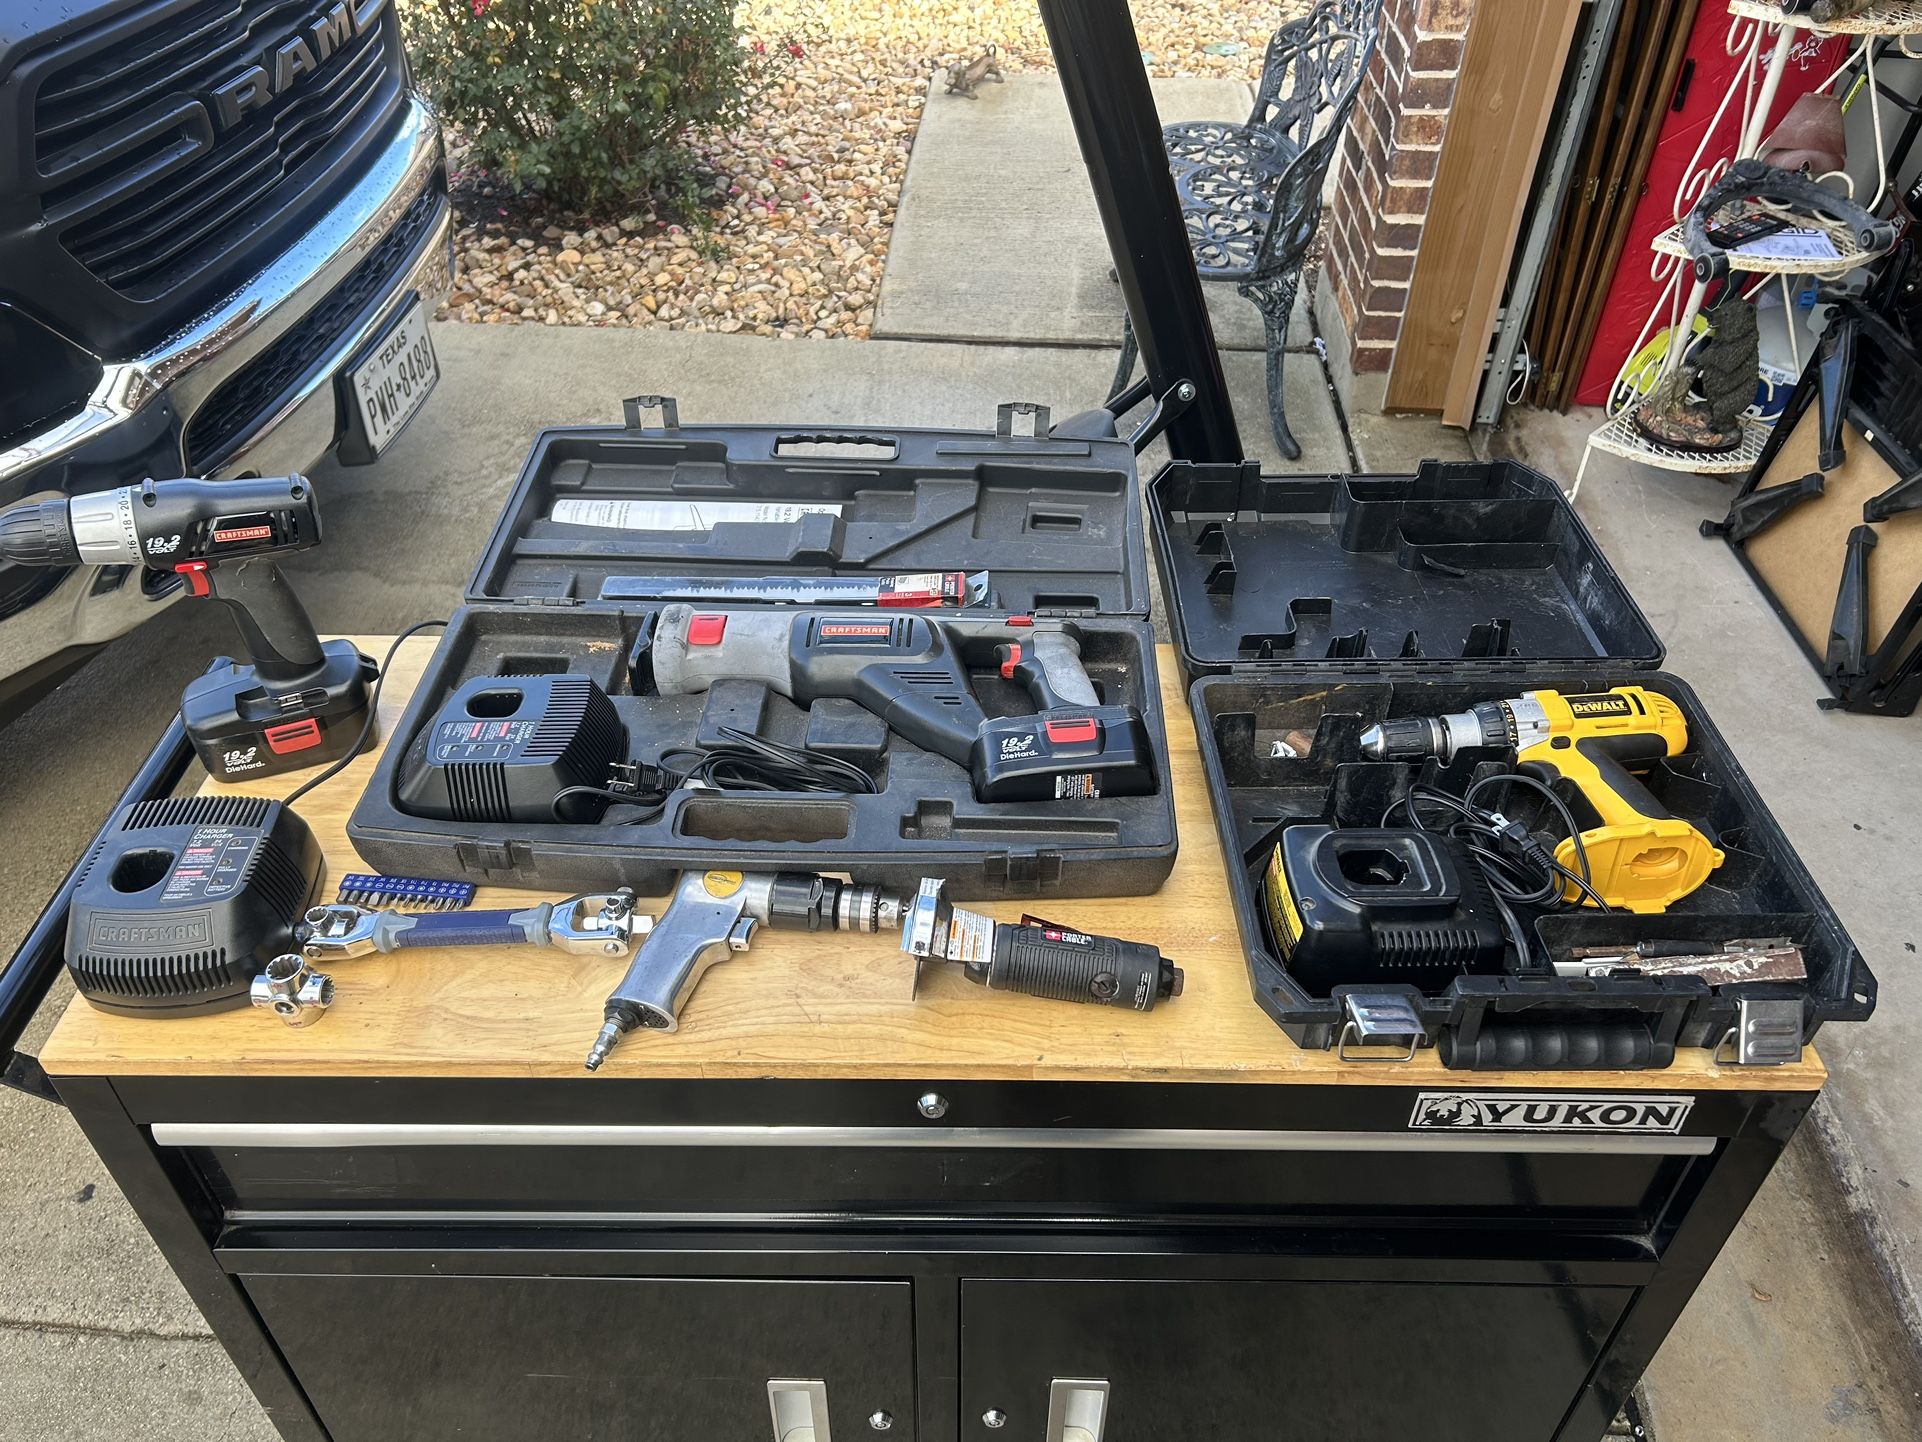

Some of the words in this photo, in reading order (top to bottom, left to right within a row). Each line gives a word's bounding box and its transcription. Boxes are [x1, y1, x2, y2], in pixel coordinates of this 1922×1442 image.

[211, 2, 352, 129] RAM
[379, 330, 407, 370] TEXAS
[122, 519, 133, 531] 18
[216, 528, 268, 541] CRAFTSMAN
[127, 540, 137, 550] 16
[146, 535, 181, 548] 19.2
[825, 626, 888, 634] CRAFTSMAN
[1001, 735, 1034, 748] 19.2
[223, 747, 257, 761] 19.2
[99, 922, 204, 942] CRAFTSMAN
[1484, 1101, 1683, 1126] YUKON
